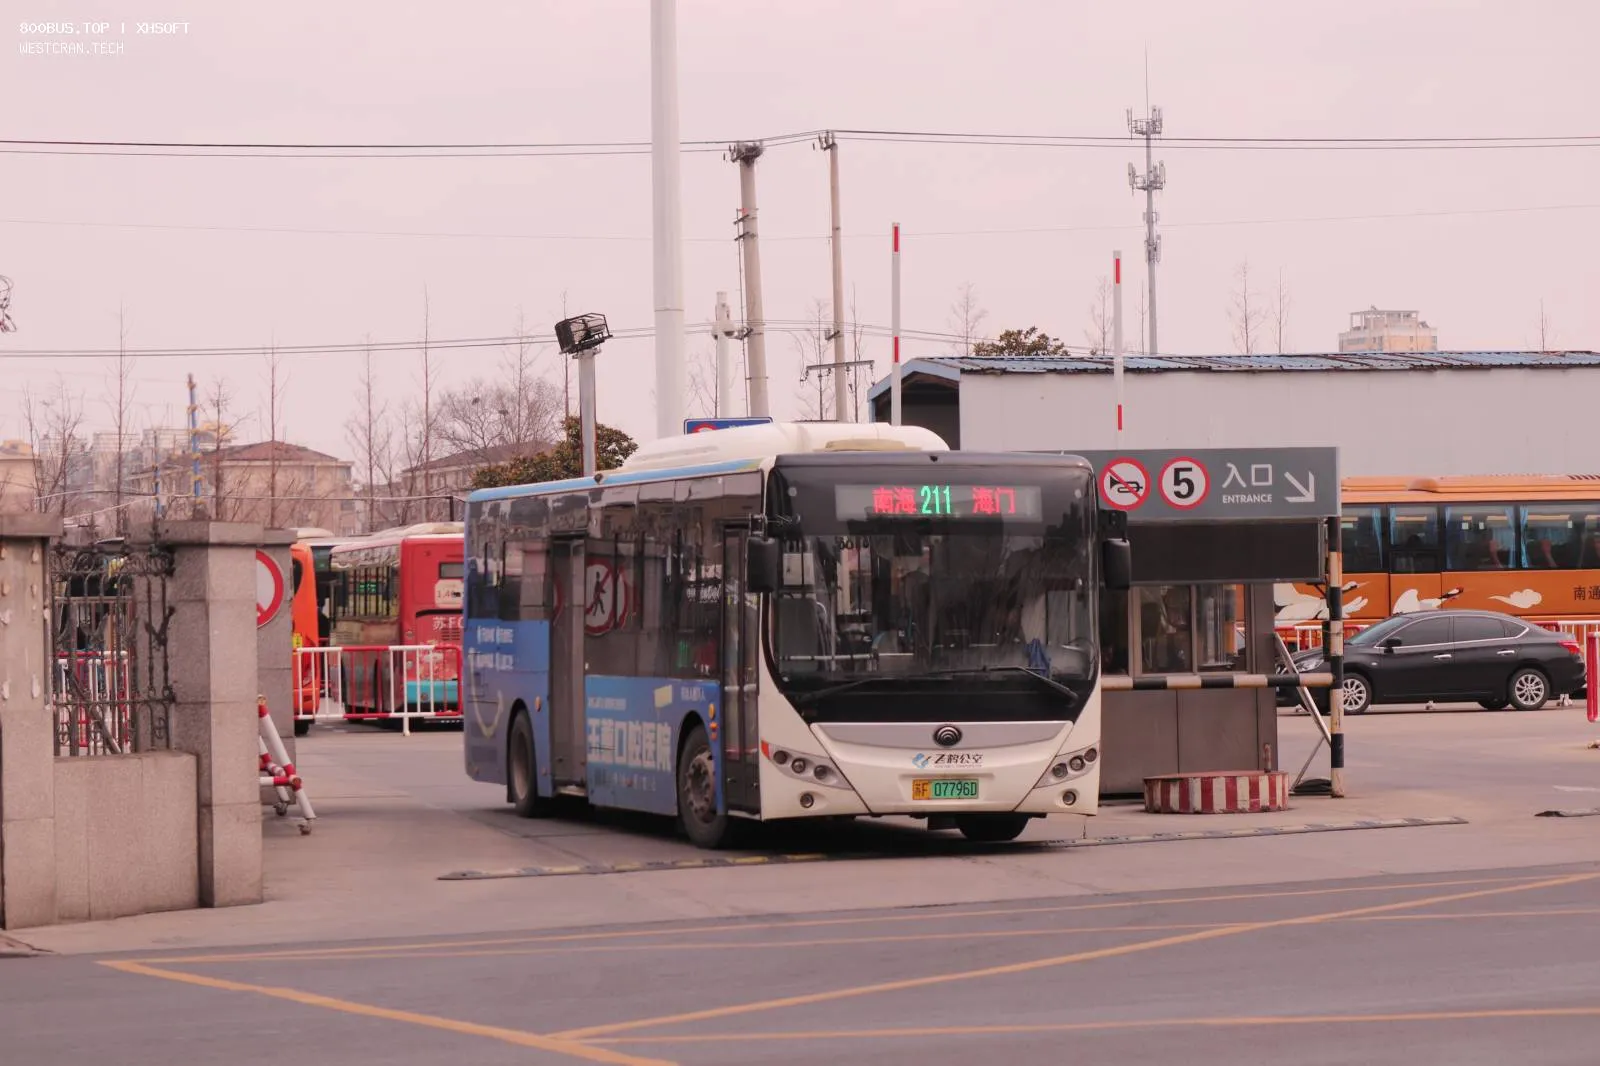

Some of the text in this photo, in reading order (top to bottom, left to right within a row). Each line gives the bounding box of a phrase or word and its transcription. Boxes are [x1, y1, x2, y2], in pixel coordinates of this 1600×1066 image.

[1173, 467, 1195, 499] 5
[1222, 463, 1273, 488] 入口
[872, 485, 1016, 514] 南海 211 海门
[1222, 494, 1273, 504] ENTRANCE
